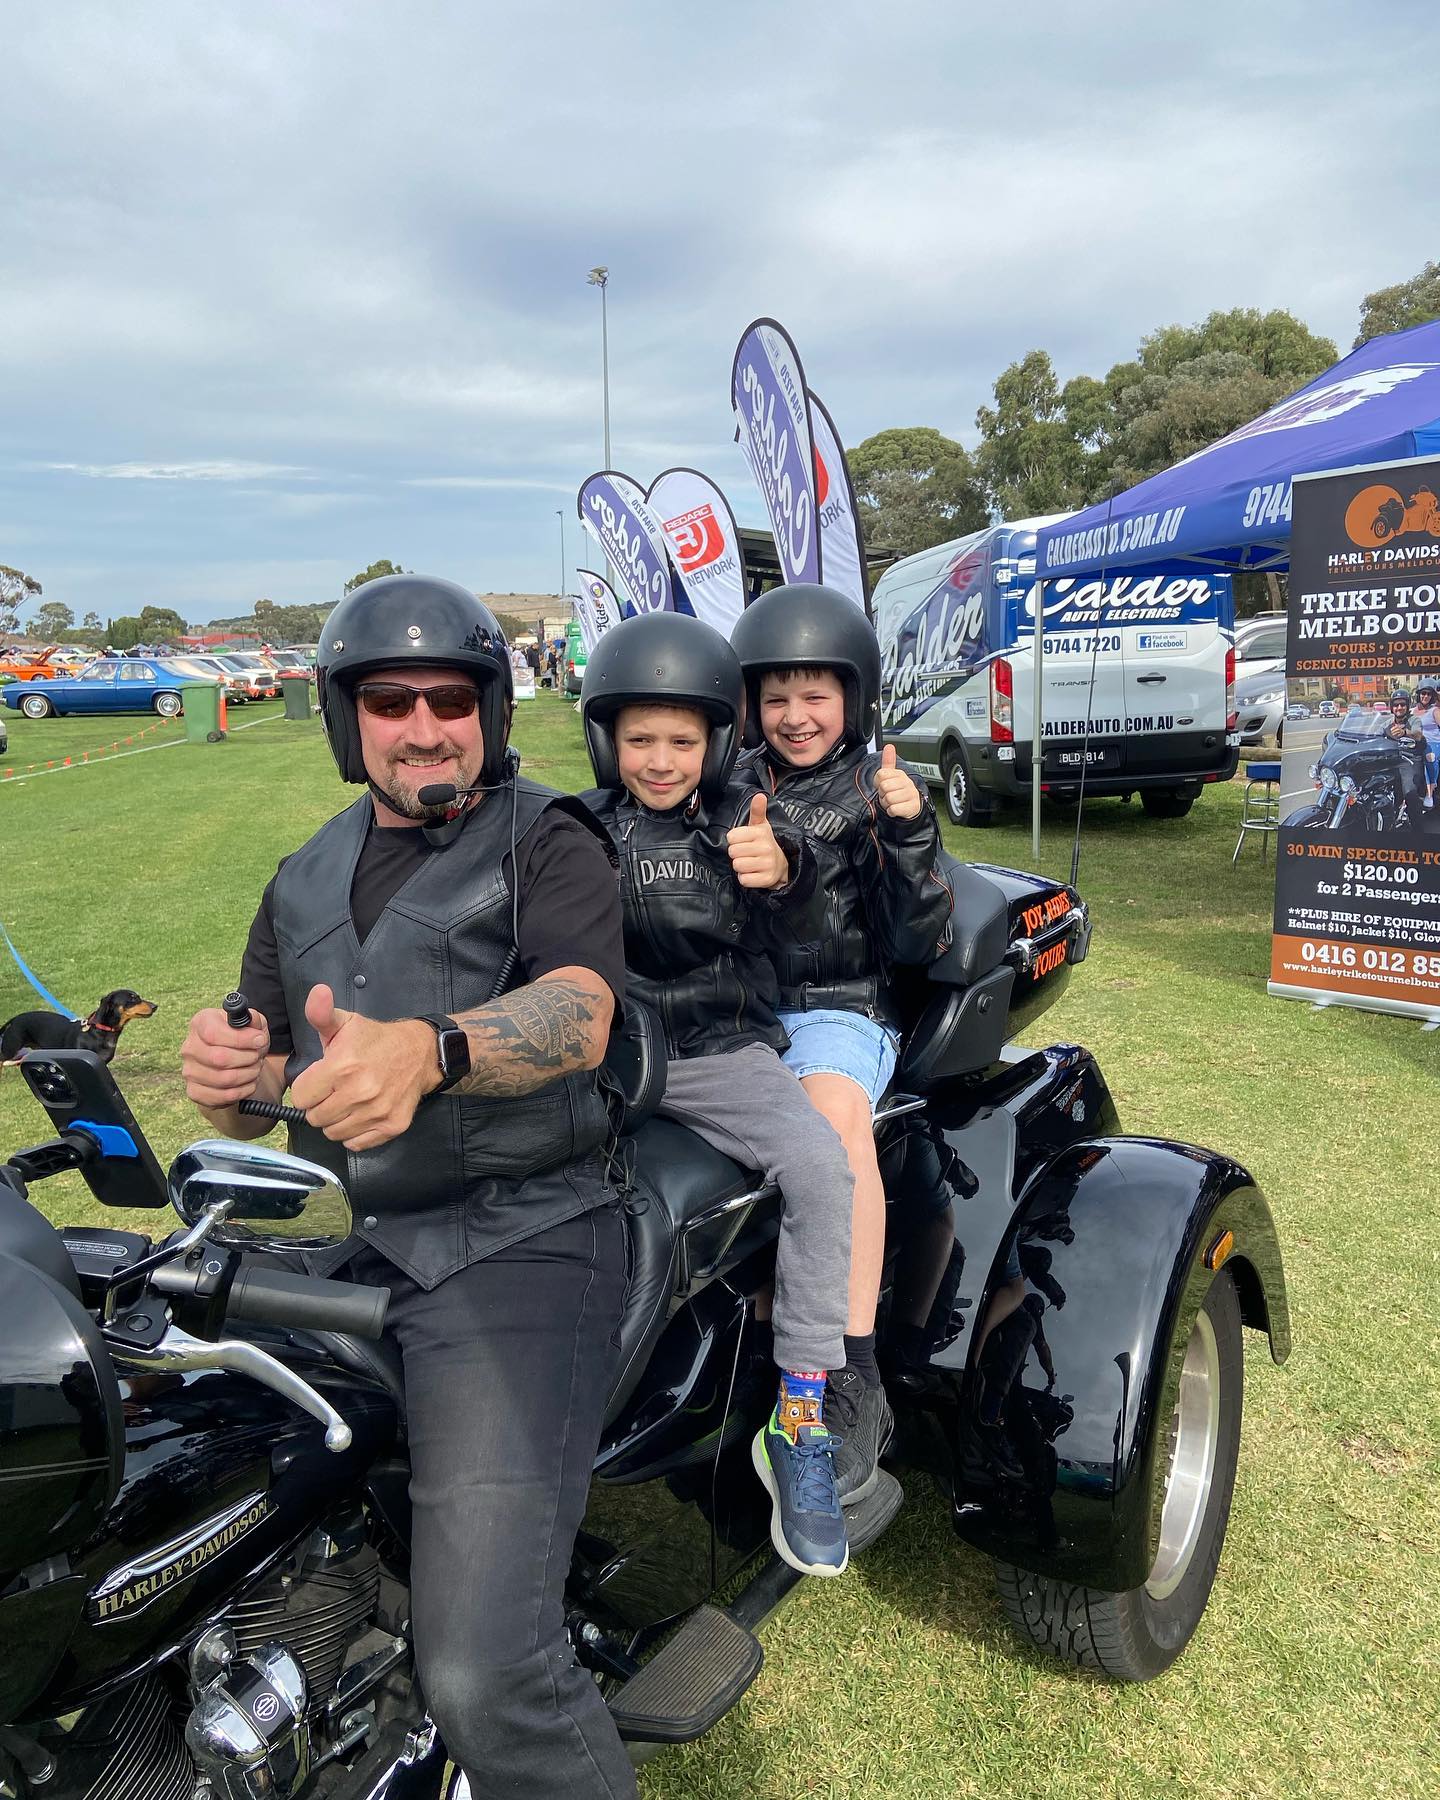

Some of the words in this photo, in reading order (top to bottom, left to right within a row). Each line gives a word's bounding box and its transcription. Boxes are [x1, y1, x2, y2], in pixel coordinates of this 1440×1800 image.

[1242, 482, 1292, 528] 9744
[1046, 506, 1187, 568] CALDERAUTO.COM.AU
[1328, 550, 1381, 566] HARLEY
[1384, 545, 1440, 561] DAVIDS
[686, 557, 736, 587] NETWORK
[1328, 566, 1357, 574] TRIKE
[1360, 563, 1394, 572] TOURS
[1025, 575, 1212, 618] Calder
[1301, 589, 1387, 614] TRIKE
[1393, 585, 1440, 609] TO
[1060, 610, 1101, 623] AUTO
[1105, 607, 1182, 621] ELECTRICS
[1043, 638, 1083, 654] 9744
[1084, 635, 1121, 652] 7220
[1152, 640, 1184, 648] facebook
[1329, 643, 1376, 655] TOURS
[1296, 659, 1348, 671] SCENIC
[1349, 656, 1394, 669] RIDES
[1406, 655, 1440, 668] WED
[1287, 844, 1305, 857] 30
[1307, 845, 1343, 859] MIN
[1346, 847, 1419, 864] SPECIAL
[640, 860, 713, 886] DAVIDSON
[1343, 861, 1419, 884] $120.00
[1317, 881, 1339, 895] for
[1341, 883, 1352, 896] 2
[1022, 904, 1044, 937] JOY
[1331, 911, 1361, 923] HIRE
[1363, 914, 1382, 926] OF
[1288, 919, 1326, 932] Helmet
[1328, 922, 1350, 936] $10,
[1351, 925, 1387, 939] Jacket
[1388, 928, 1412, 942] $10,
[1033, 939, 1067, 980] TOURS
[1301, 943, 1356, 965] 0416
[1363, 949, 1406, 973] 012
[1413, 956, 1440, 977] 85
[98, 1499, 268, 1617] HARLEY-DAVIDSON
